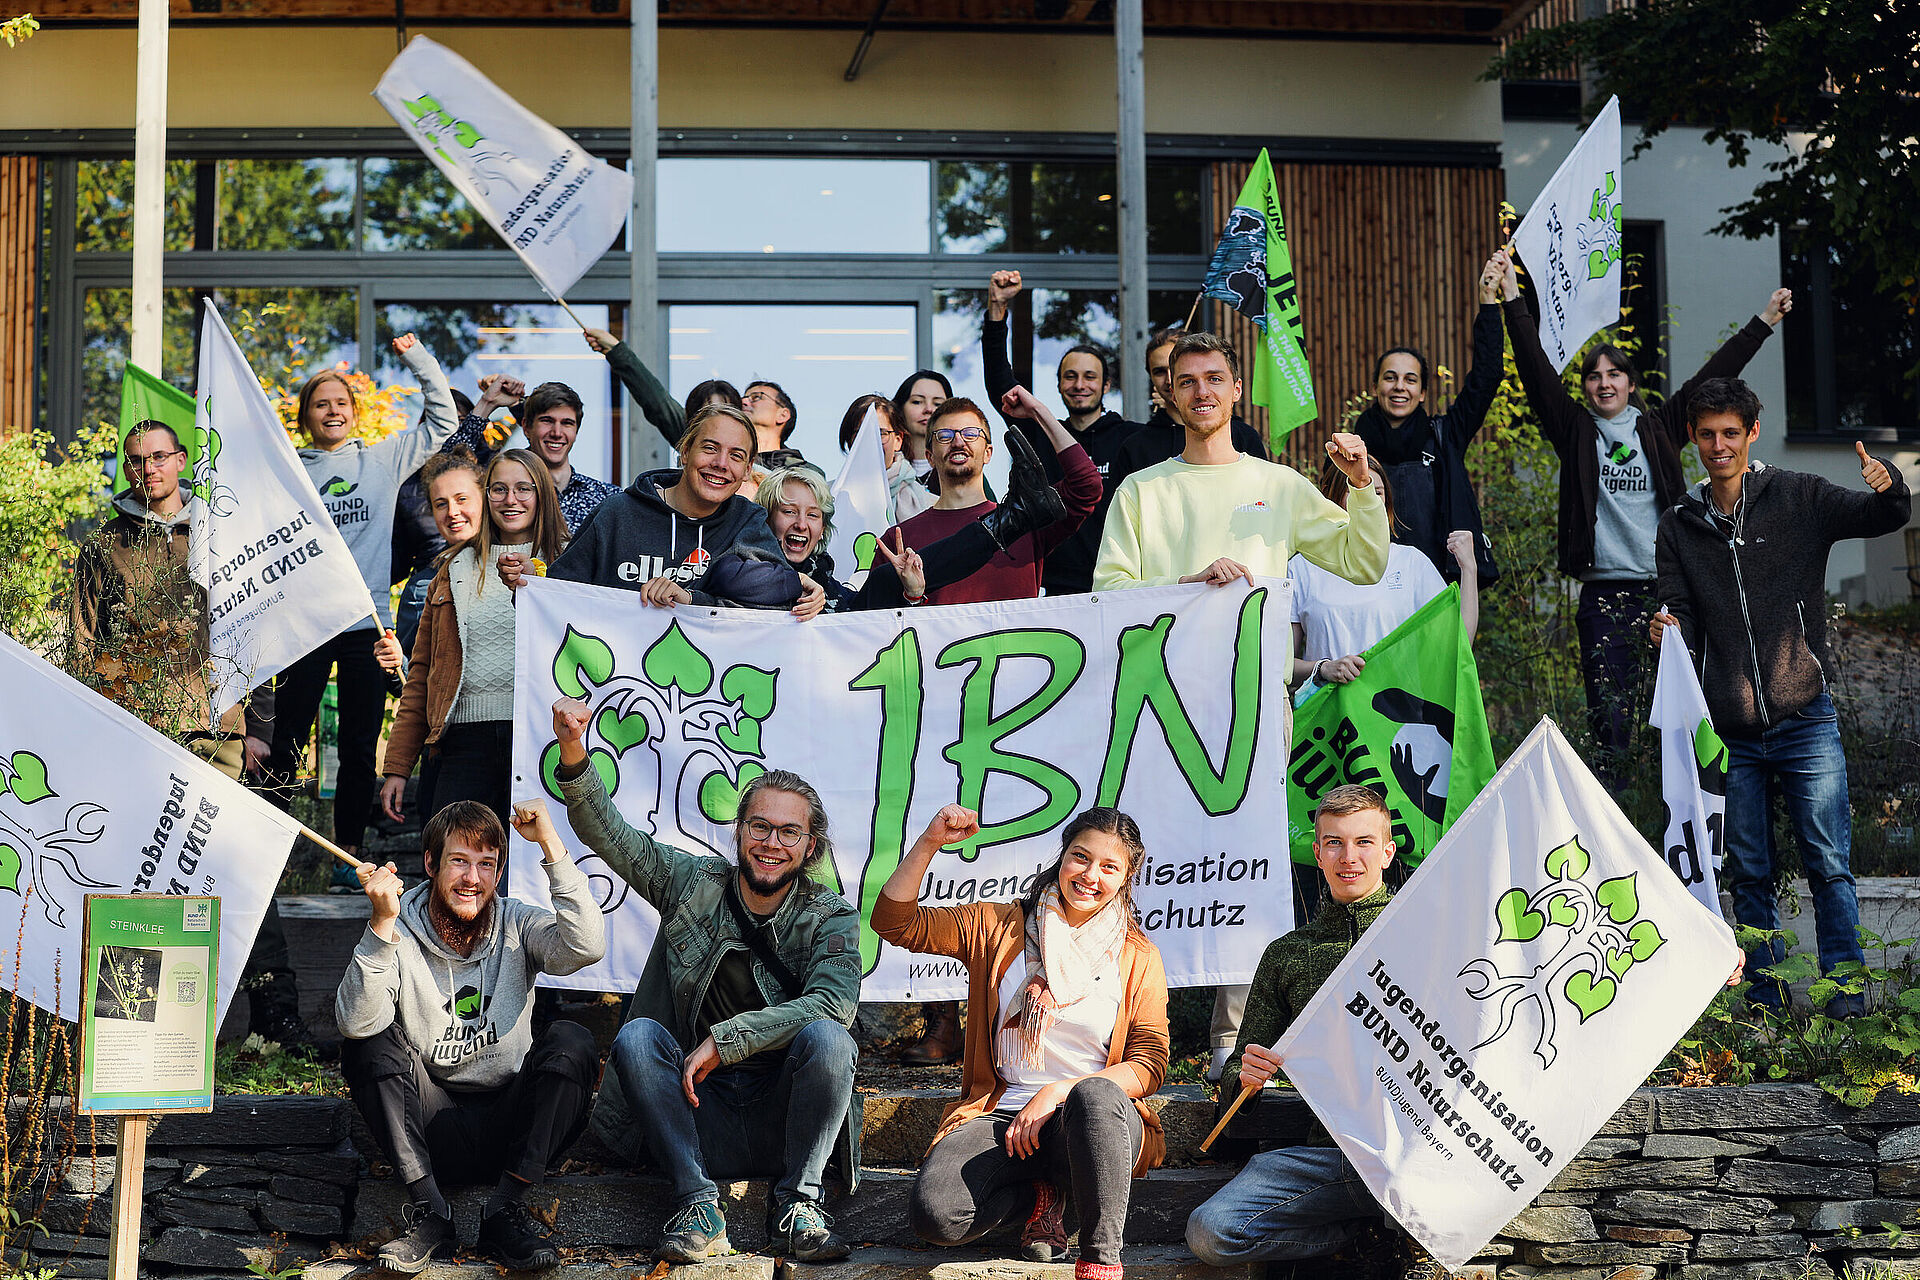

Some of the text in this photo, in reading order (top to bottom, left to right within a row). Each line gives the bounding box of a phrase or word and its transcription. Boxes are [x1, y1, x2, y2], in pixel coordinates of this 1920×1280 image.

[513, 227, 539, 250] UND
[1279, 334, 1295, 355] THE
[1601, 465, 1643, 478] BUND
[333, 505, 370, 528] gend
[848, 587, 1268, 979] JBN
[109, 919, 165, 935] STEINKLEE
[442, 1015, 488, 1041] BUND
[430, 1021, 499, 1064] jugend
[1367, 959, 1555, 1167] Jugendorganisation
[1345, 991, 1526, 1192] BUND Naturschutz
[1375, 1065, 1454, 1161] BUNDjugend Bayern
